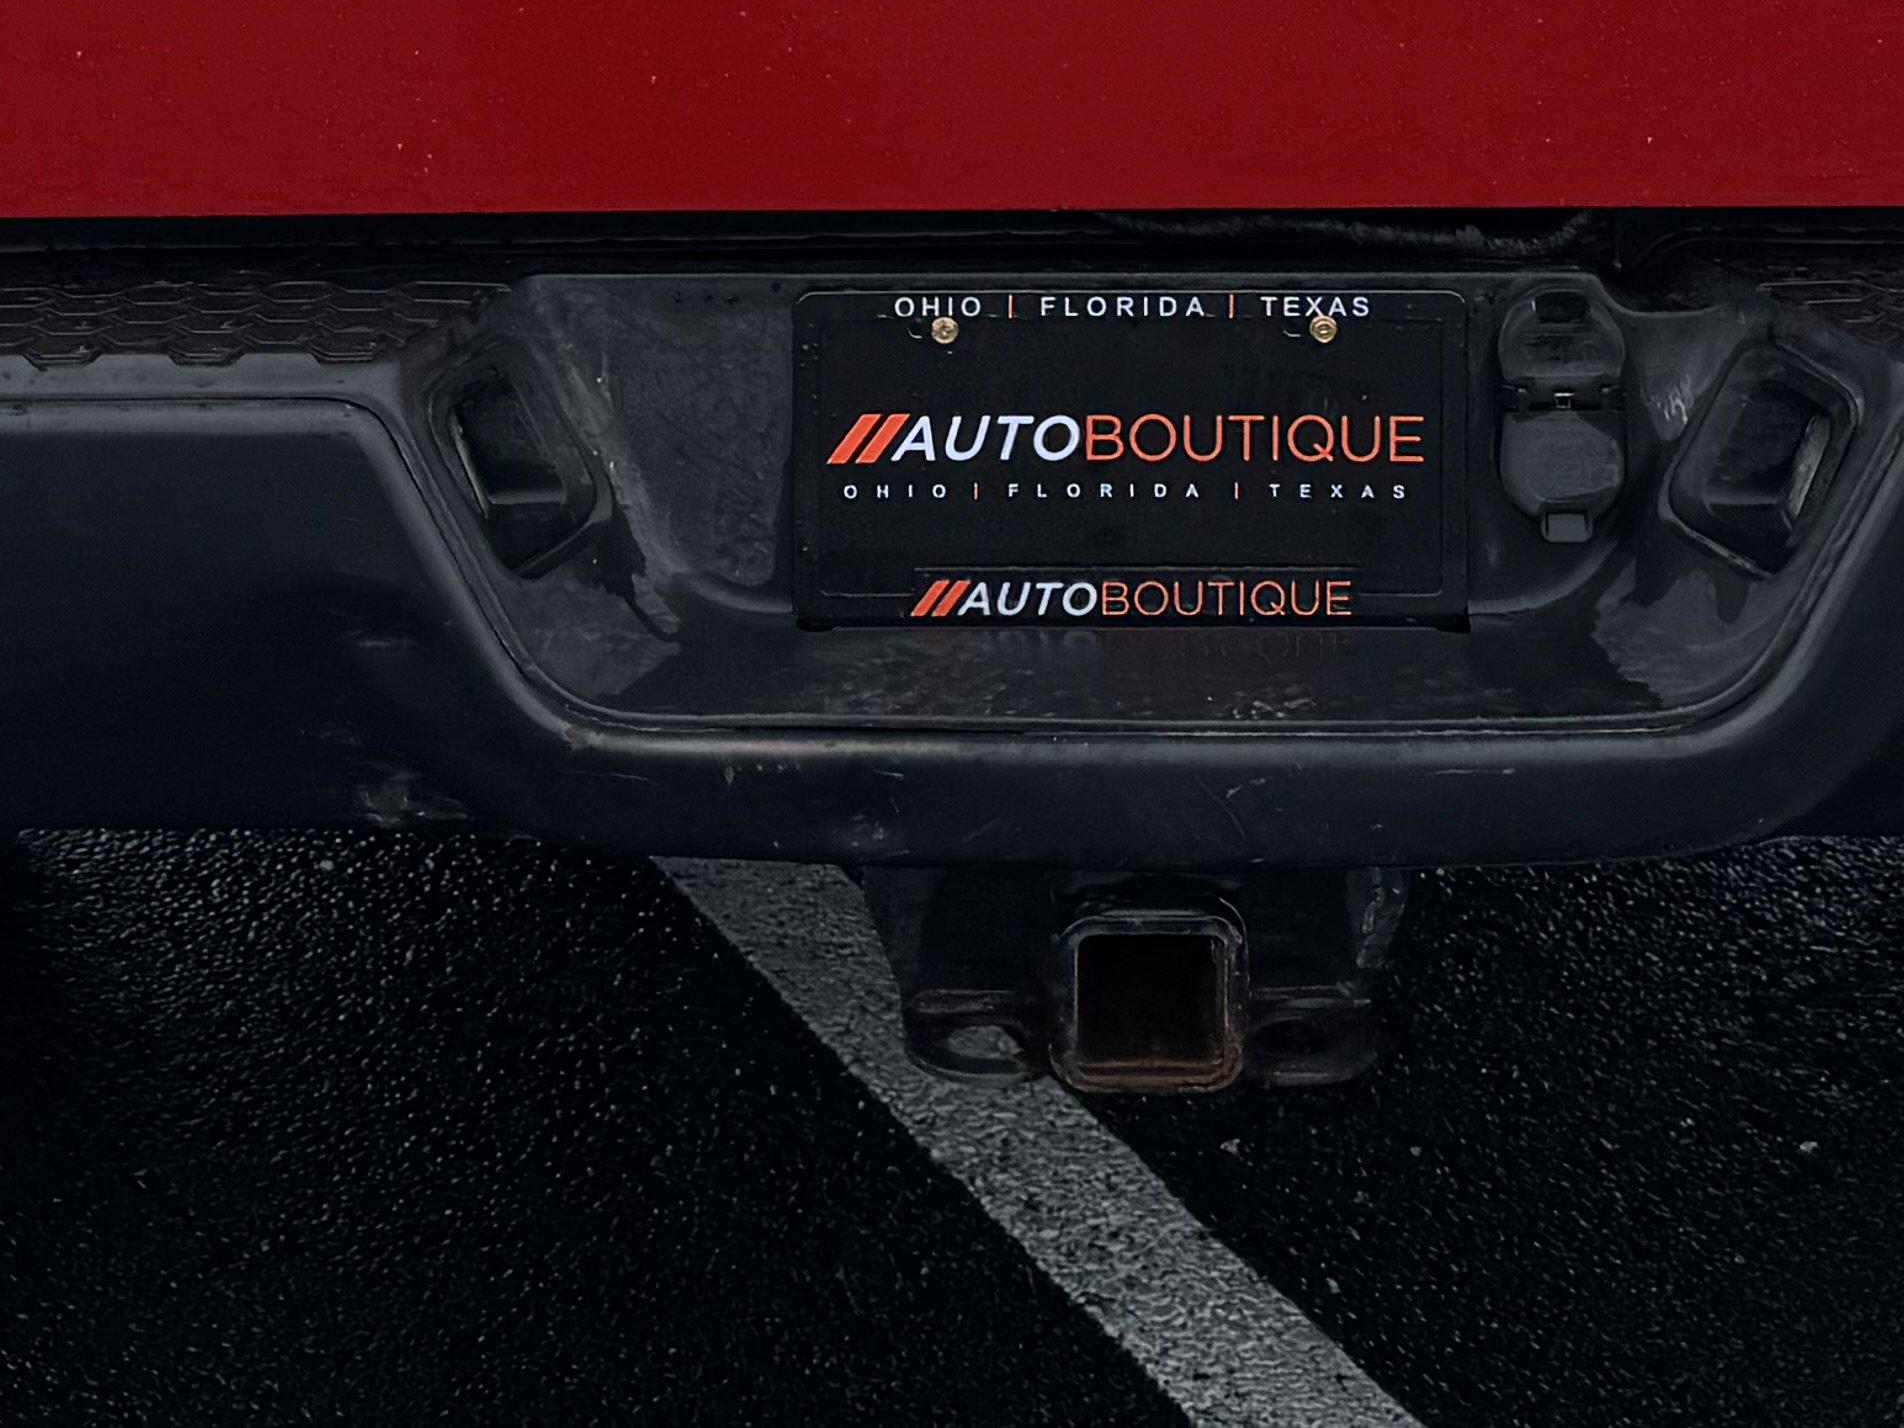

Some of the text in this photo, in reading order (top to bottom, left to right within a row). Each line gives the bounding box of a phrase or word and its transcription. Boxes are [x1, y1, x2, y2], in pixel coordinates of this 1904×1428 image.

[894, 295, 1371, 319] OHIO FLORIDA TEXAS
[890, 413, 1426, 463] AUTOBOUTIQUE
[843, 482, 1407, 500] OHIO FLORIDA TEXAS
[957, 579, 1353, 617] AUTOBOUTIQUE
